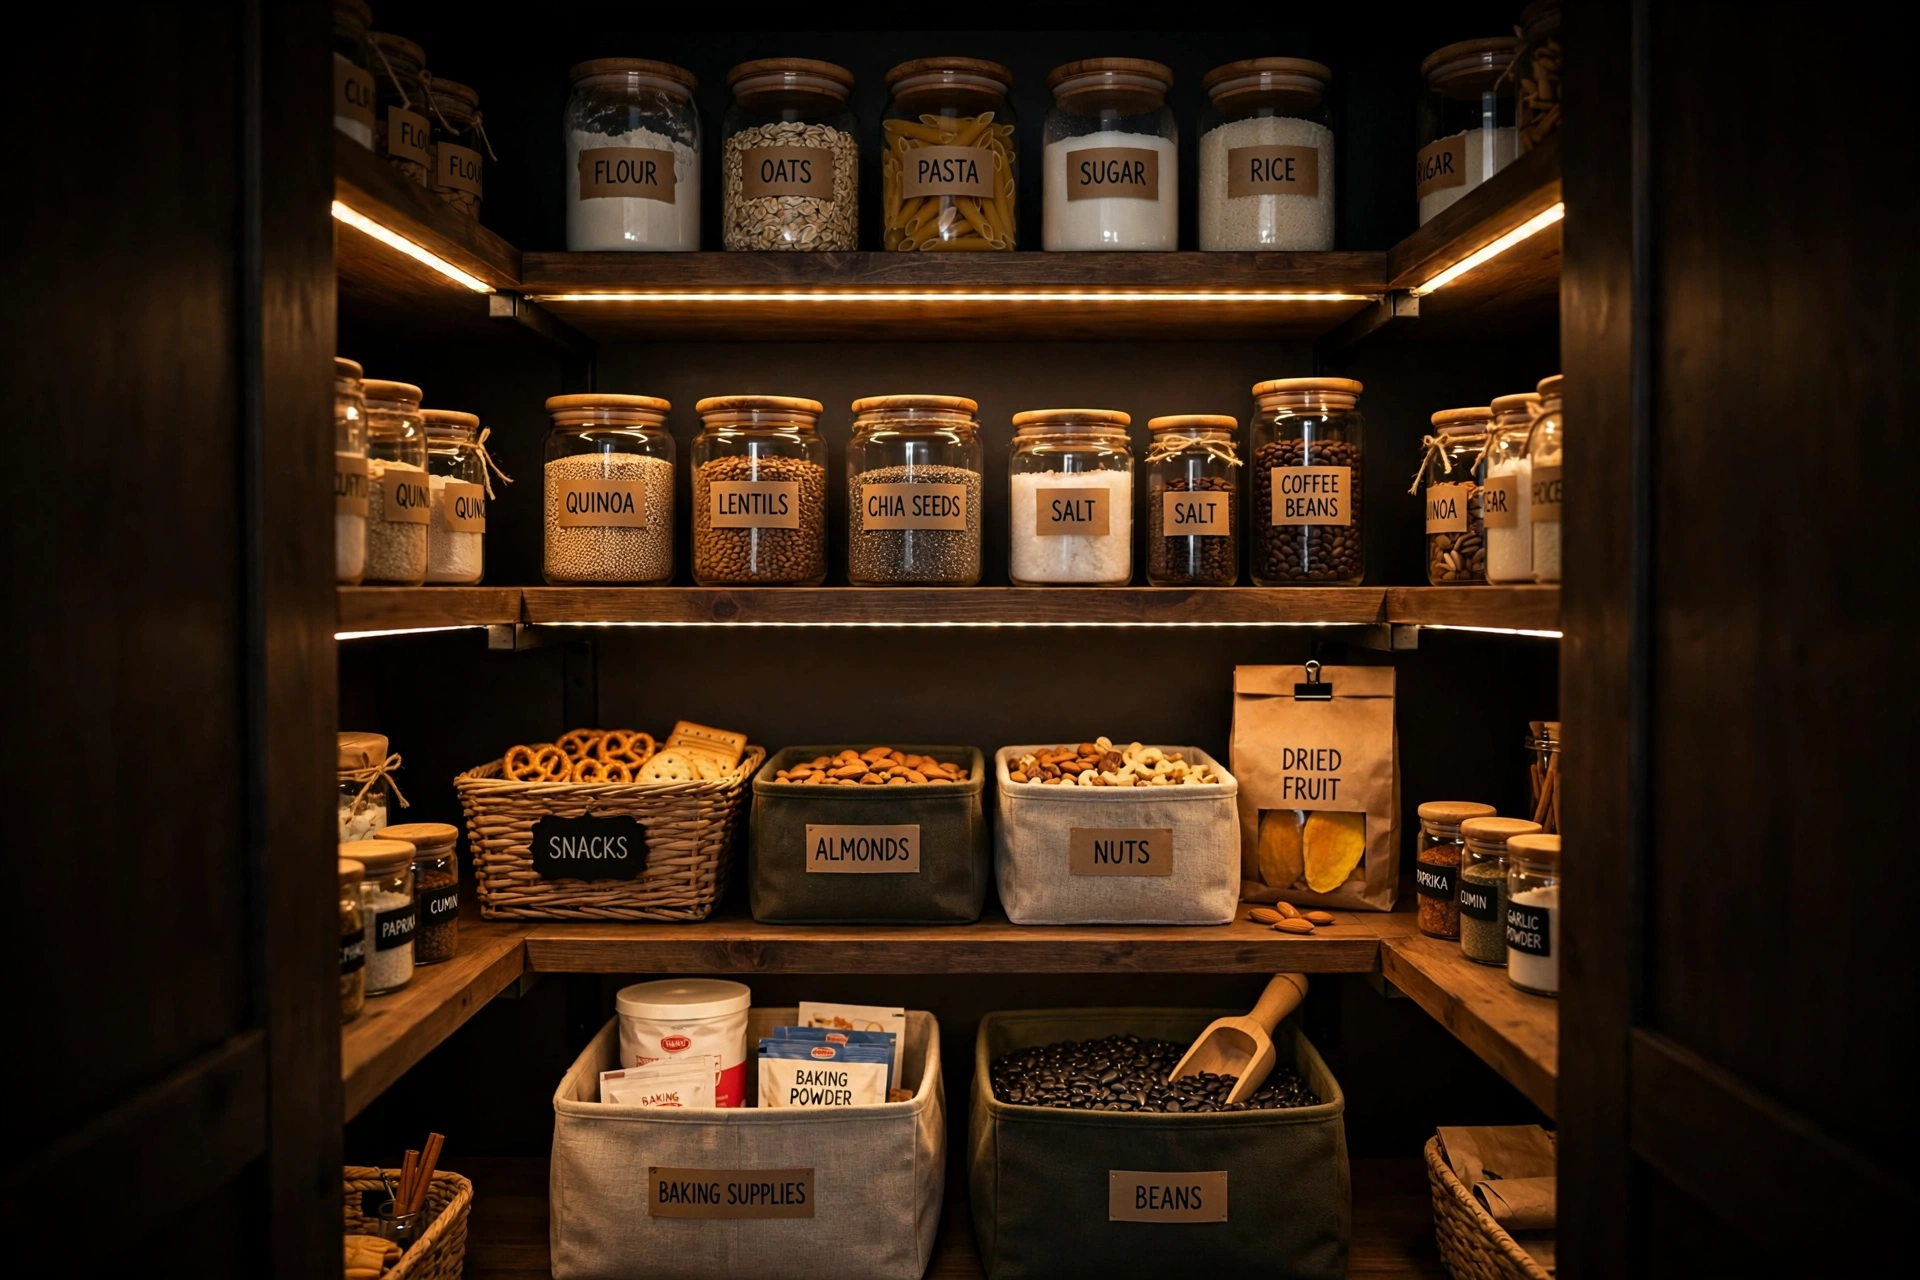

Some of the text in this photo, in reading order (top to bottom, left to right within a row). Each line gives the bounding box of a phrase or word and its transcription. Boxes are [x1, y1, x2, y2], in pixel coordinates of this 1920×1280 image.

[595, 159, 658, 186] FLOUR
[761, 158, 812, 184] OATS
[918, 158, 979, 184] PASTA
[1080, 159, 1147, 186] SUGAR
[1250, 157, 1296, 183] RICE
[1281, 474, 1340, 495] COFFEE
[566, 491, 635, 515] QUINOA
[719, 493, 789, 516] LENTILS
[868, 495, 961, 518] CHIA SEEDS
[1051, 499, 1096, 522] SALT
[1174, 502, 1218, 524] SALT
[1285, 497, 1338, 518] BEANS
[1282, 747, 1342, 772] DRIED
[1283, 776, 1341, 801] FRUIT
[549, 835, 628, 859] SNACKS
[815, 837, 910, 862] ALMONDS
[1094, 840, 1150, 865] NUTS
[1507, 909, 1540, 930] GARLIC
[795, 1069, 848, 1088] BAKING
[641, 1091, 679, 1106] BAKING
[789, 1087, 852, 1106] POWDER
[659, 1180, 806, 1206] BAKING SUPPLIES
[1135, 1185, 1202, 1210] BEANS
